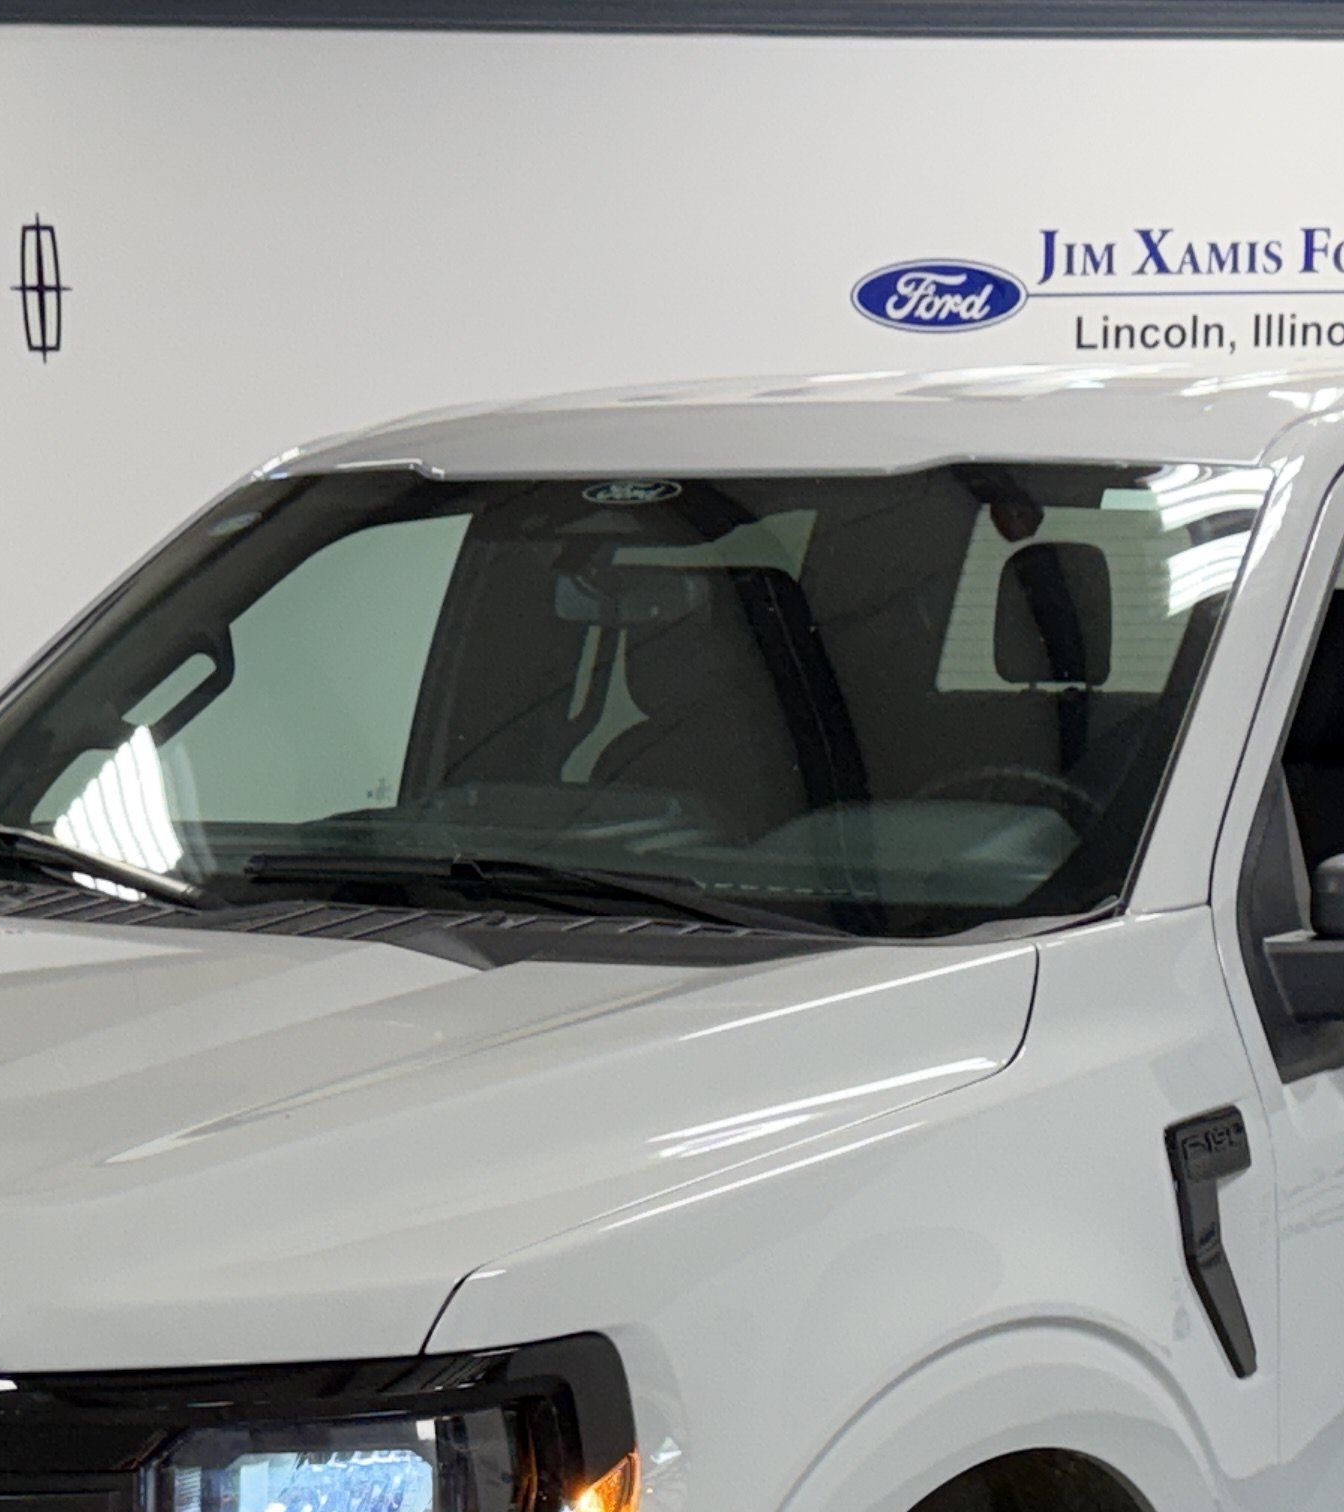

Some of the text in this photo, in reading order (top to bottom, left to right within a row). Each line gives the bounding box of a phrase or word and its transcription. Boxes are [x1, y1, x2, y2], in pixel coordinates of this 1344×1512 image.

[1038, 229, 1116, 285] JIM
[1132, 228, 1283, 275] XAMIS
[885, 271, 994, 320] Ford
[1075, 314, 1236, 355] Lincoln,
